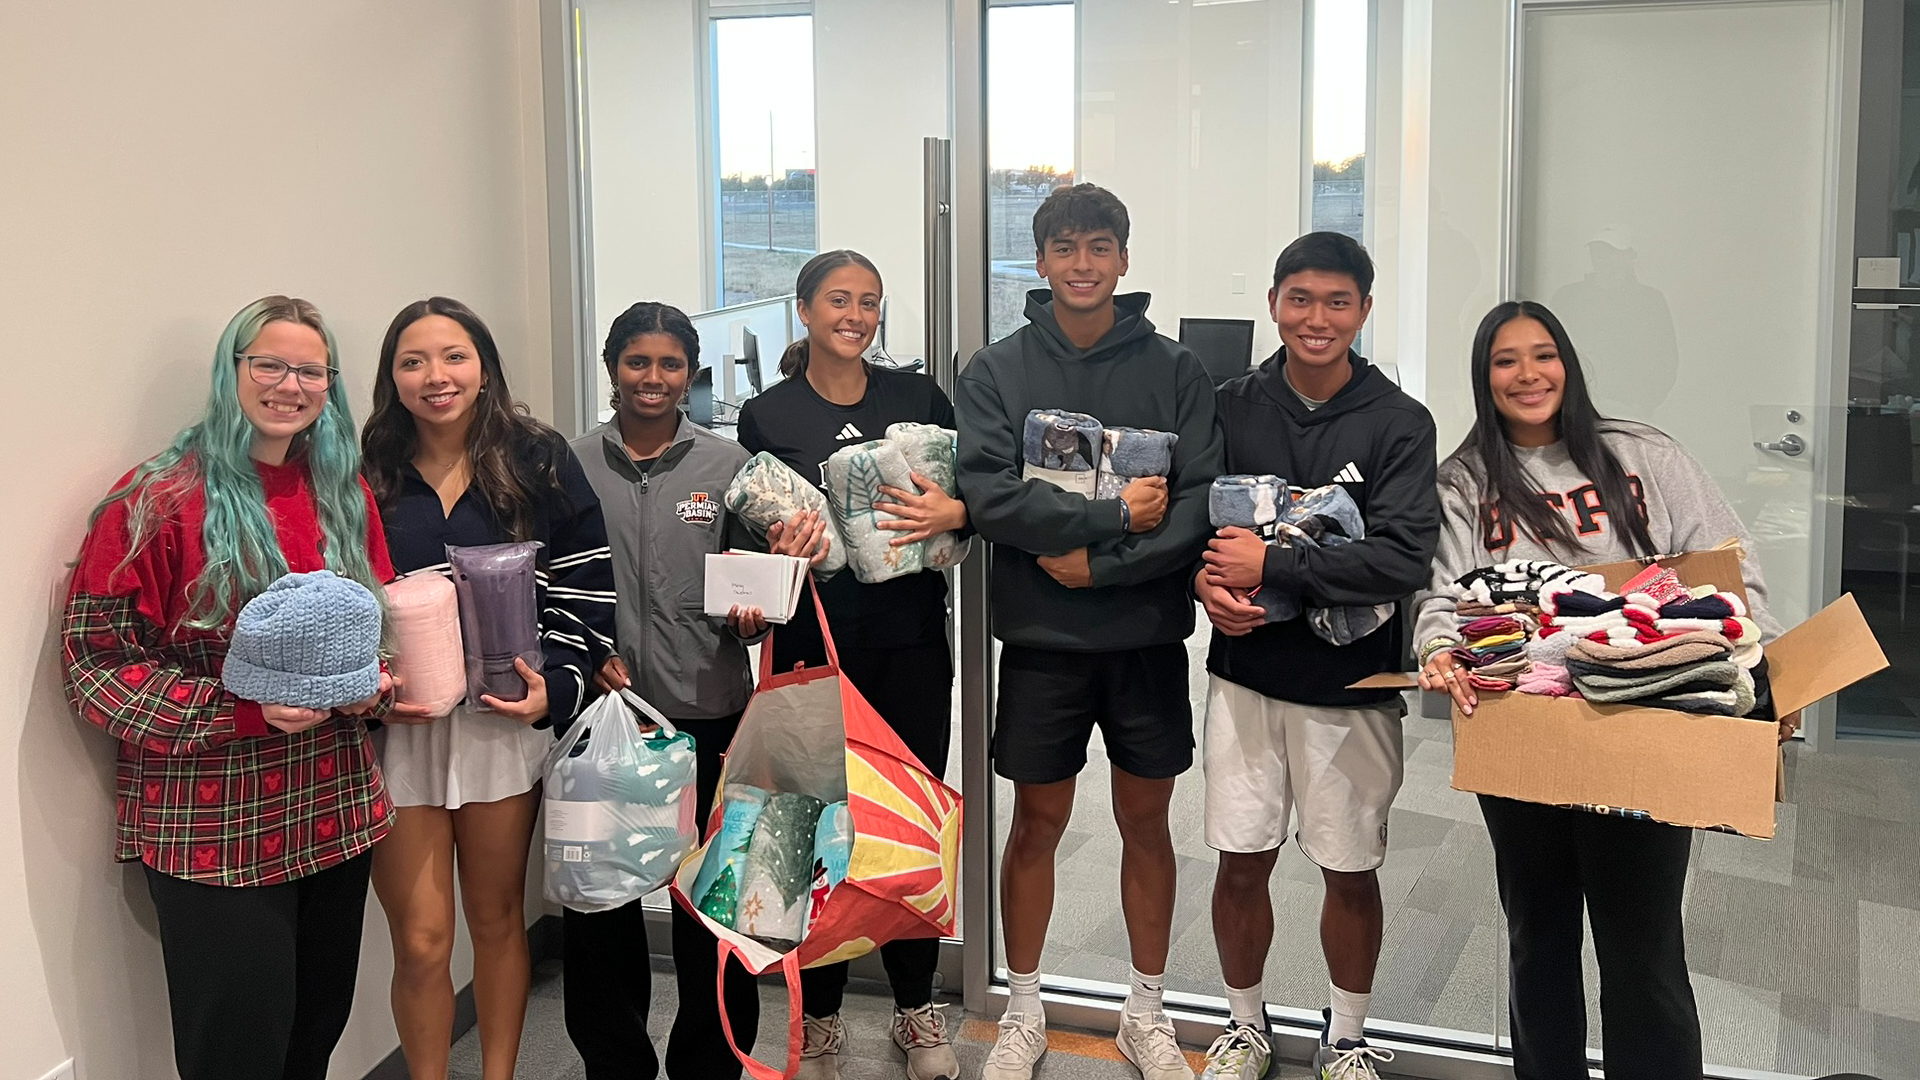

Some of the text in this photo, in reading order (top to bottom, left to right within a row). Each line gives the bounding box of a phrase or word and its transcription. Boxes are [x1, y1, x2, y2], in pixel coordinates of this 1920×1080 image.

[693, 494, 707, 502] UT
[679, 502, 718, 513] PERMIAN
[685, 509, 712, 519] BASIN
